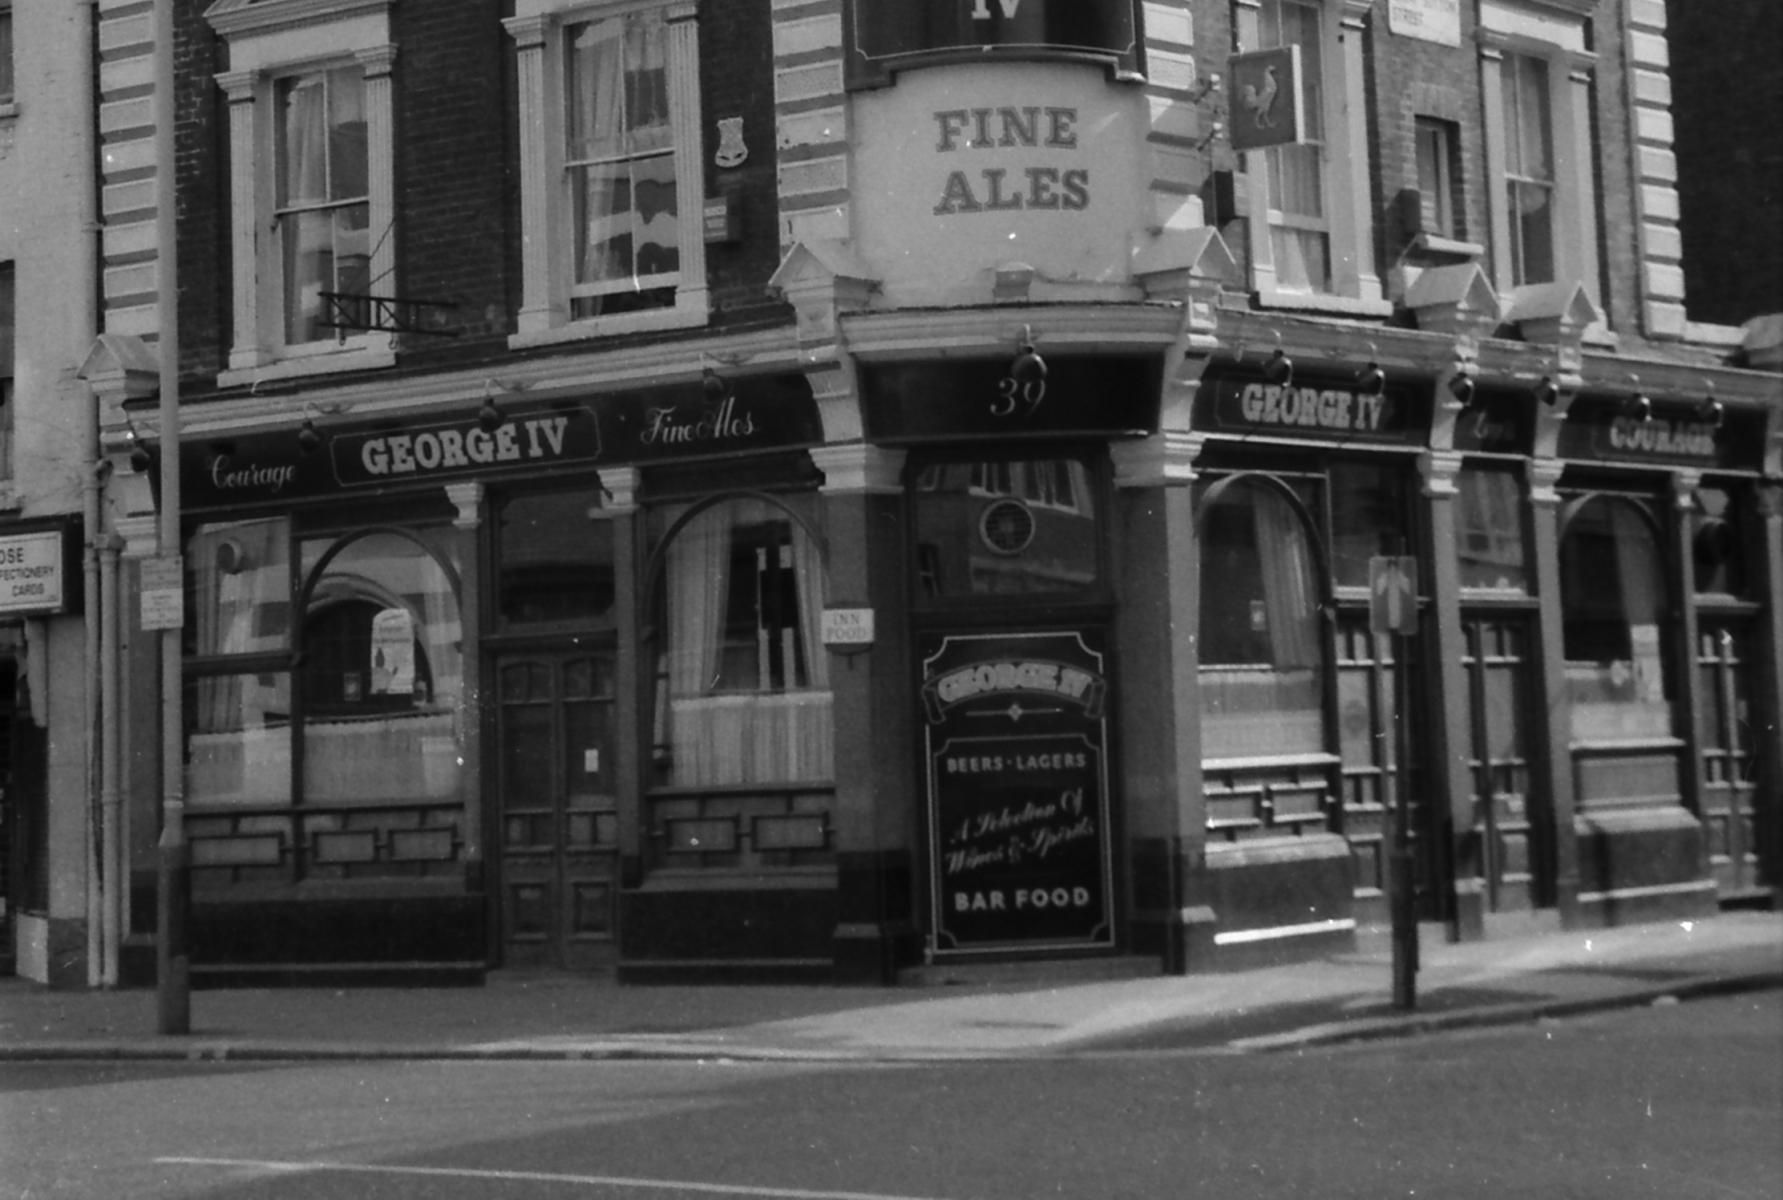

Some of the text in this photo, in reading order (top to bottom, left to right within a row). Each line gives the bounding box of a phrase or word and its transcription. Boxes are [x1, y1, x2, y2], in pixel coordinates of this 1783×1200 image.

[933, 106, 1078, 152] FINE
[933, 167, 1090, 216] ALES
[990, 377, 1045, 417] 39
[1241, 383, 1387, 430] GEORGE IV
[639, 396, 755, 445] Fine Ales
[361, 416, 569, 475] GEORGE IV
[212, 454, 296, 493] Courage
[12, 583, 45, 596] CARDS
[947, 753, 1087, 774] BEERS LAGERS
[955, 886, 1090, 912] BAR FOOD
